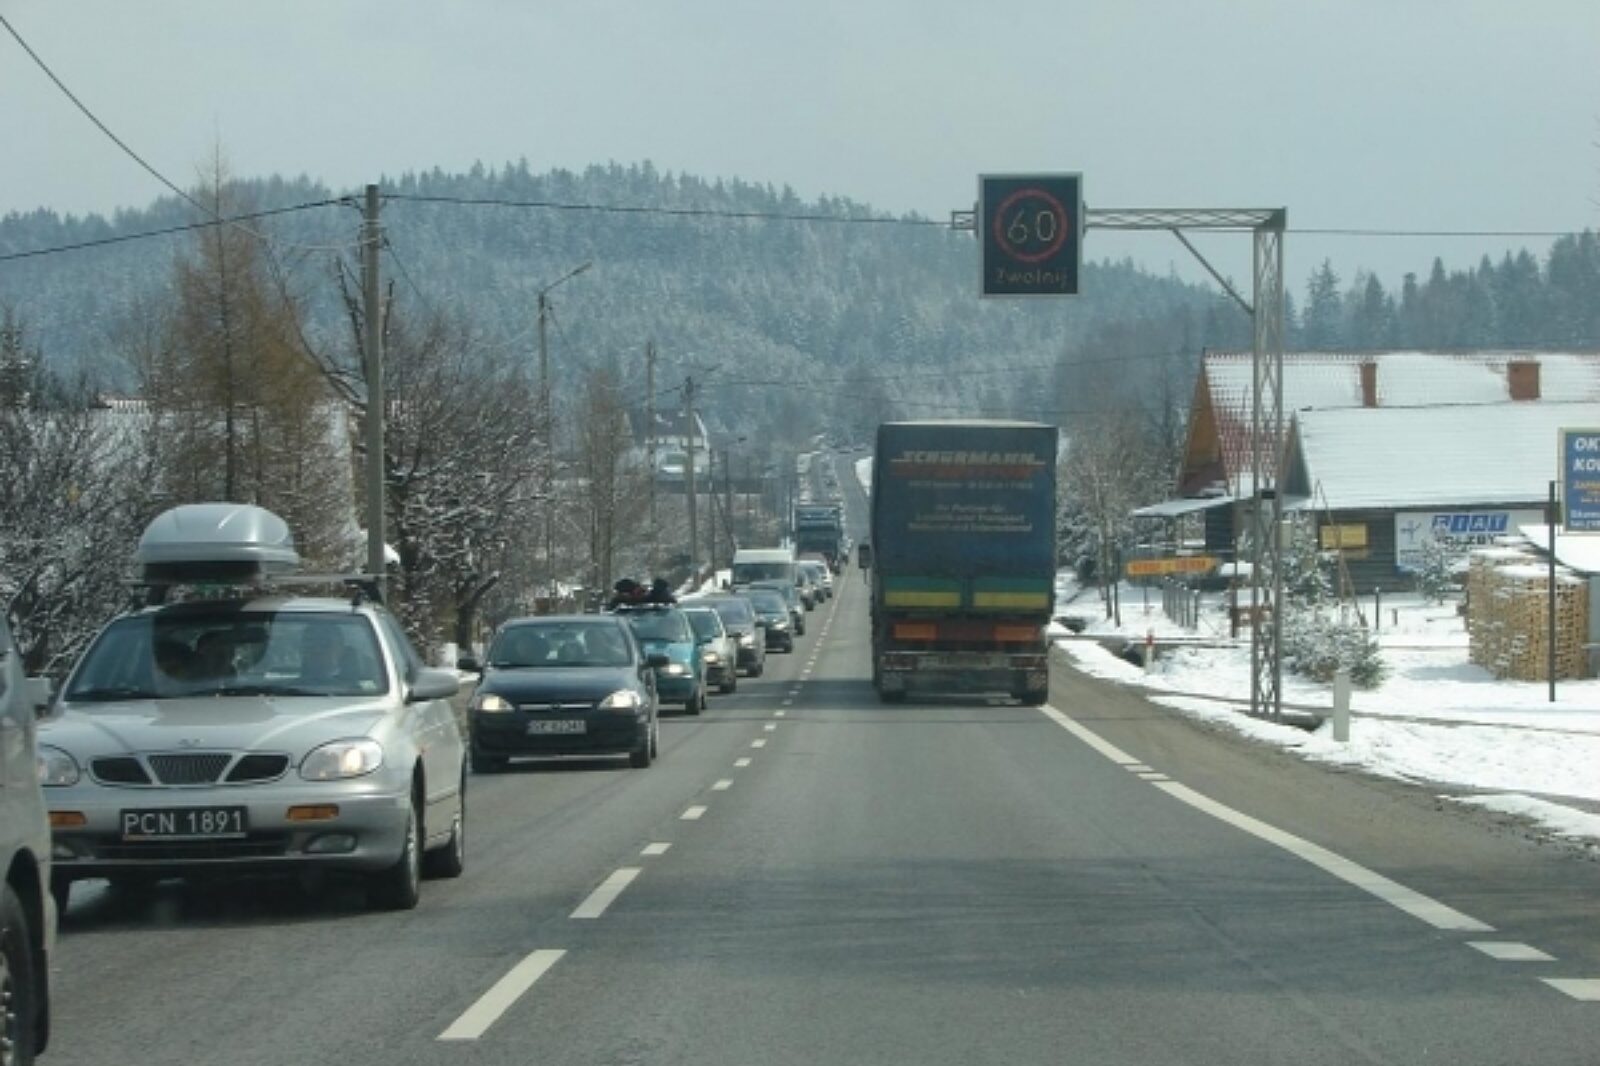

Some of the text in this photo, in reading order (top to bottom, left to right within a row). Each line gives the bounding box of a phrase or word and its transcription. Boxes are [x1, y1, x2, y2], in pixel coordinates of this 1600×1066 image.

[1007, 208, 1055, 243] 60
[124, 810, 242, 833] PCN 1891
